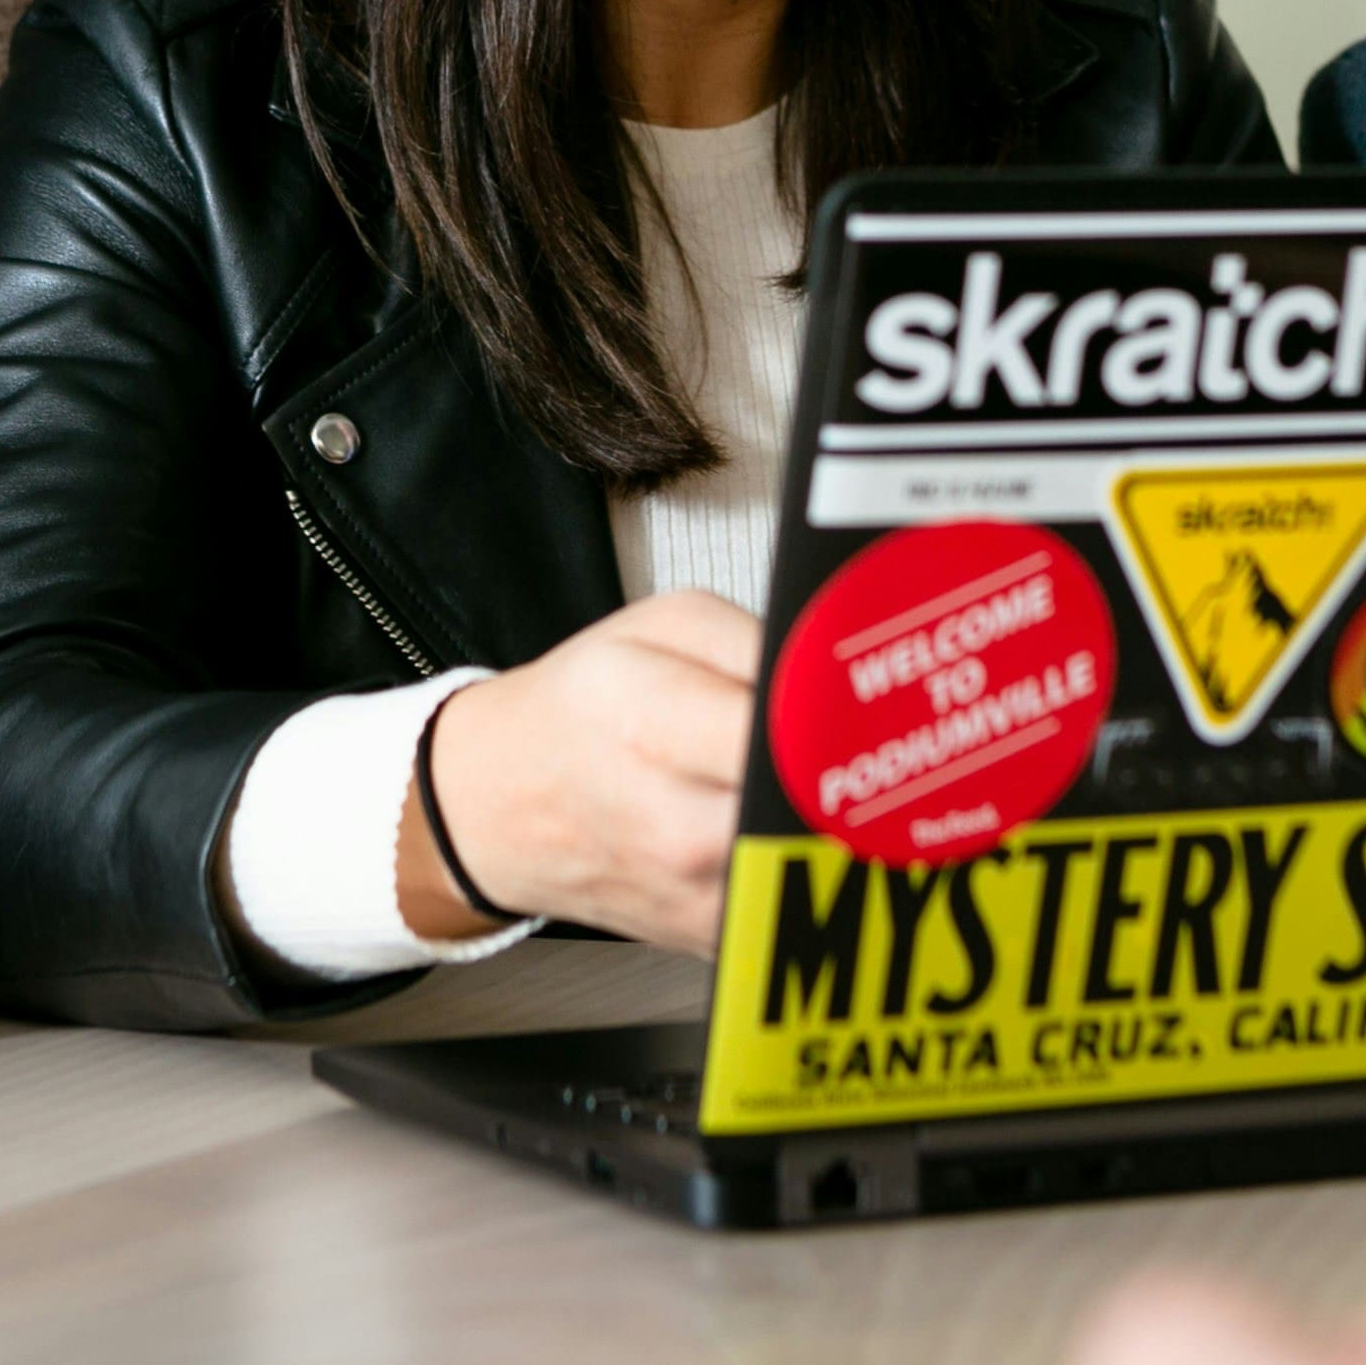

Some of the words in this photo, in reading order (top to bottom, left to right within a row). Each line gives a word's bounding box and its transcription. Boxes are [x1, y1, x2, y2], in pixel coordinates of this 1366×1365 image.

[848, 572, 1055, 703] WELCOME
[924, 656, 987, 714] TO
[819, 649, 1097, 817] PODIUMVILLE
[761, 824, 1312, 1025] MYSTERY
[798, 1028, 1000, 1089] SANTA
[1029, 1012, 1204, 1067] CRUZ,
